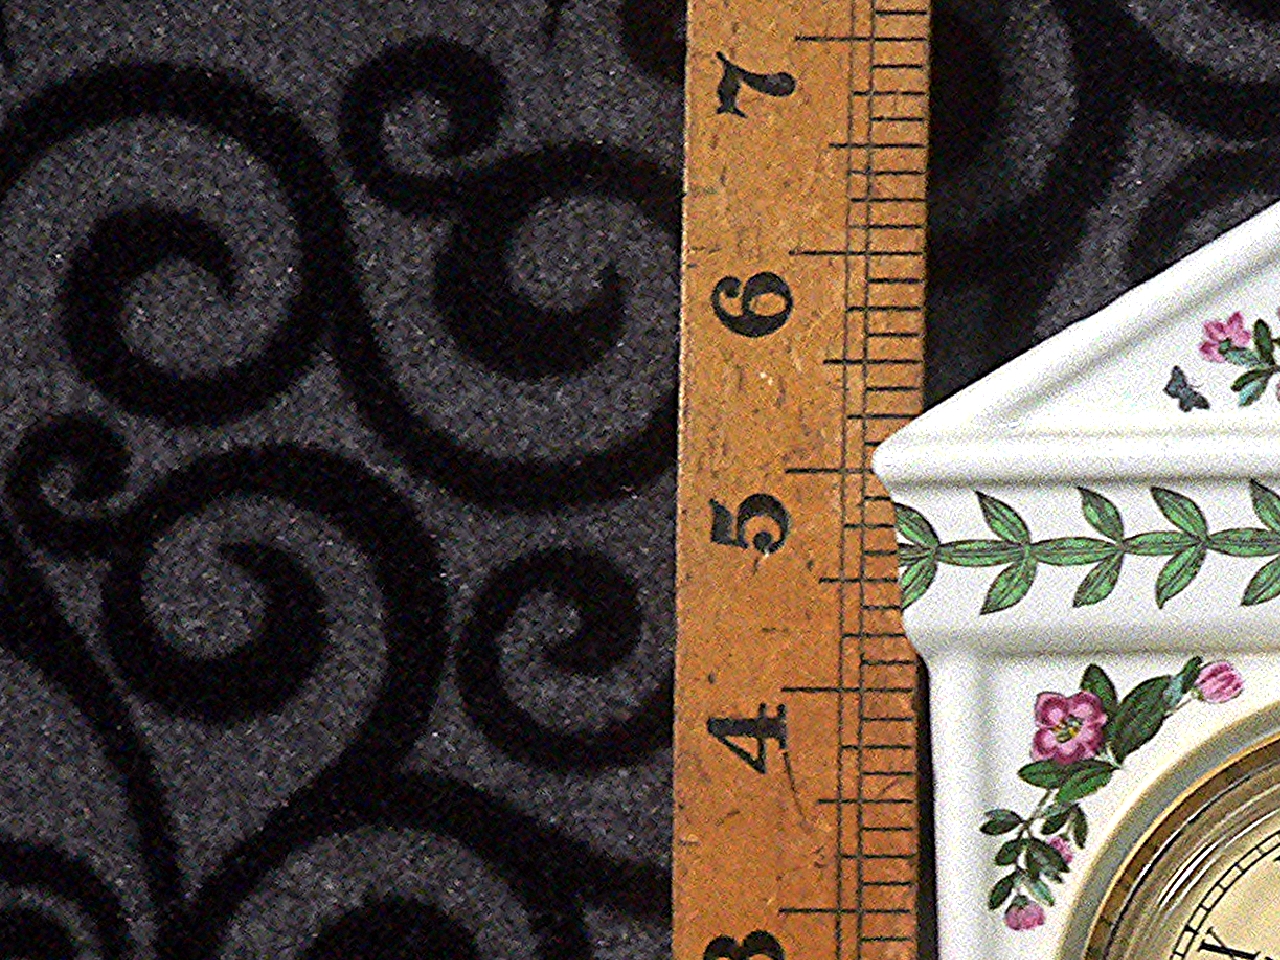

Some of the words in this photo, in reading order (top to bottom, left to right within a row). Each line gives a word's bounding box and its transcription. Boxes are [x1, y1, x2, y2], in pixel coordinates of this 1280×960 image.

[716, 51, 796, 119] 7
[711, 270, 793, 338] 6
[710, 493, 791, 555] 5
[707, 701, 787, 774] 4
